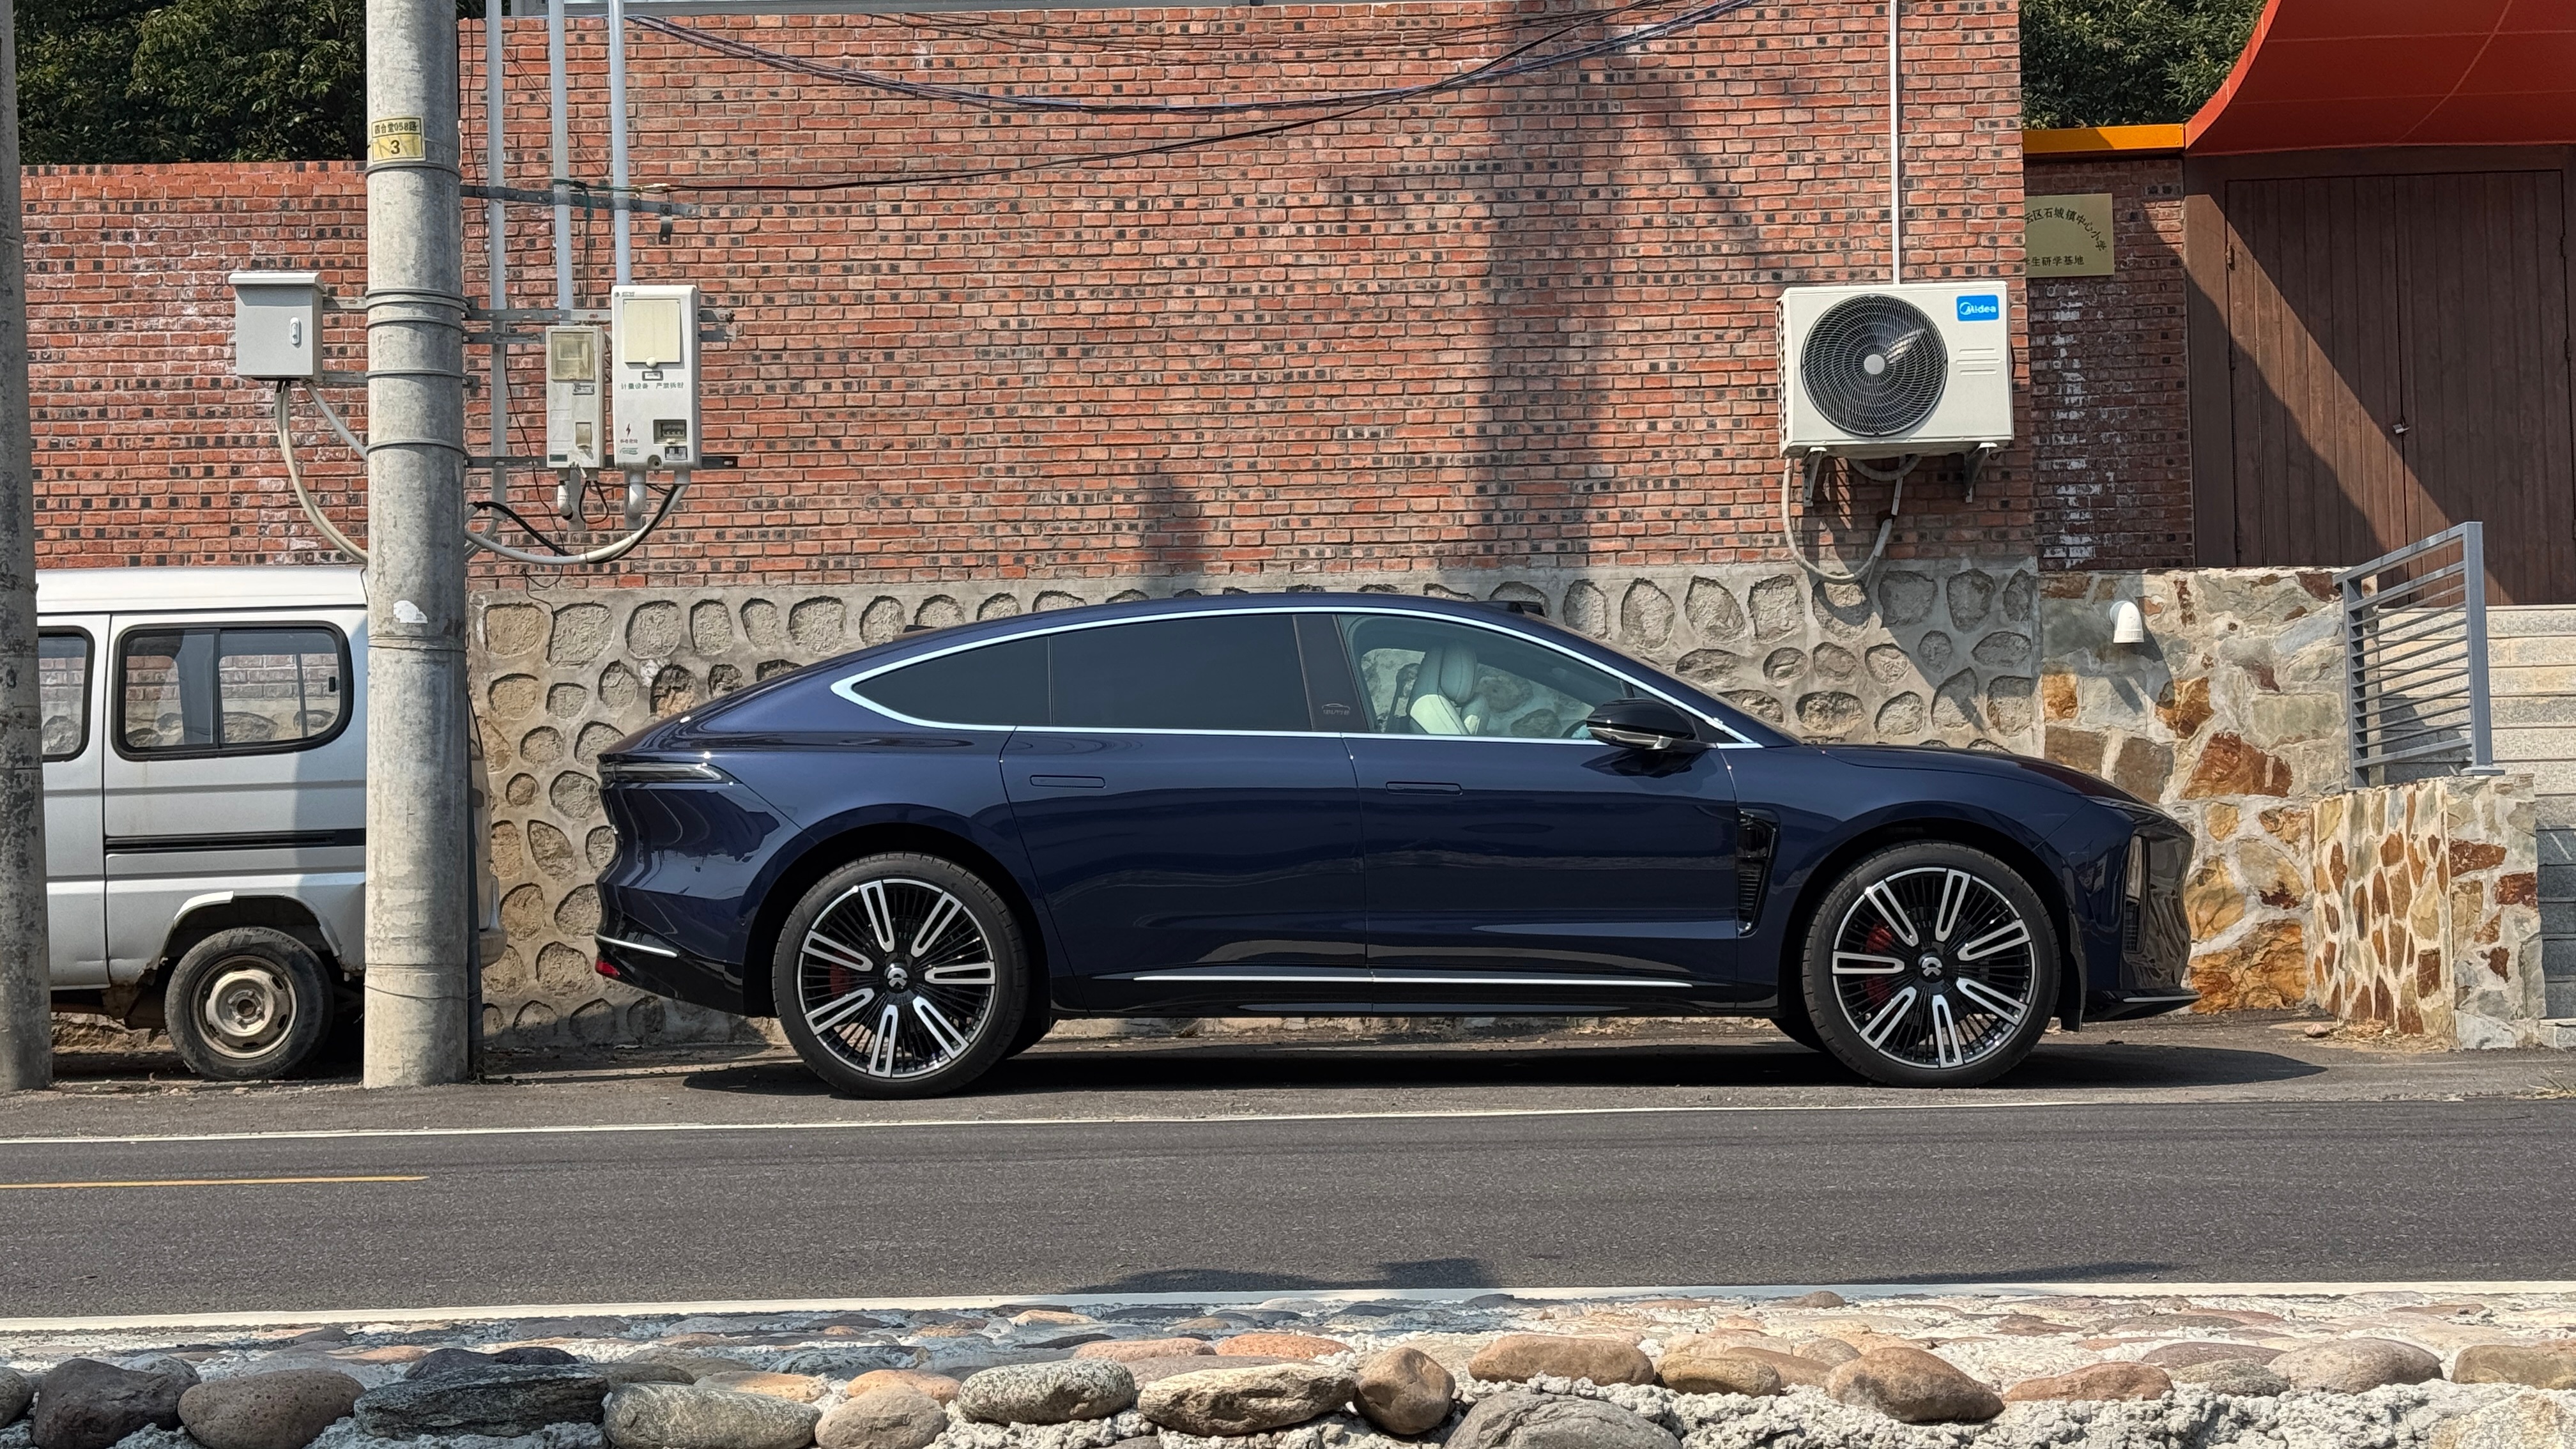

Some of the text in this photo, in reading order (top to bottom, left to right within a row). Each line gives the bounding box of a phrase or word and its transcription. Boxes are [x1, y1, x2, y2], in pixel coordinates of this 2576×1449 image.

[390, 140, 400, 155] 3
[2025, 206, 2107, 252] 云区石城镇中心小学
[1959, 302, 1997, 316] Midea
